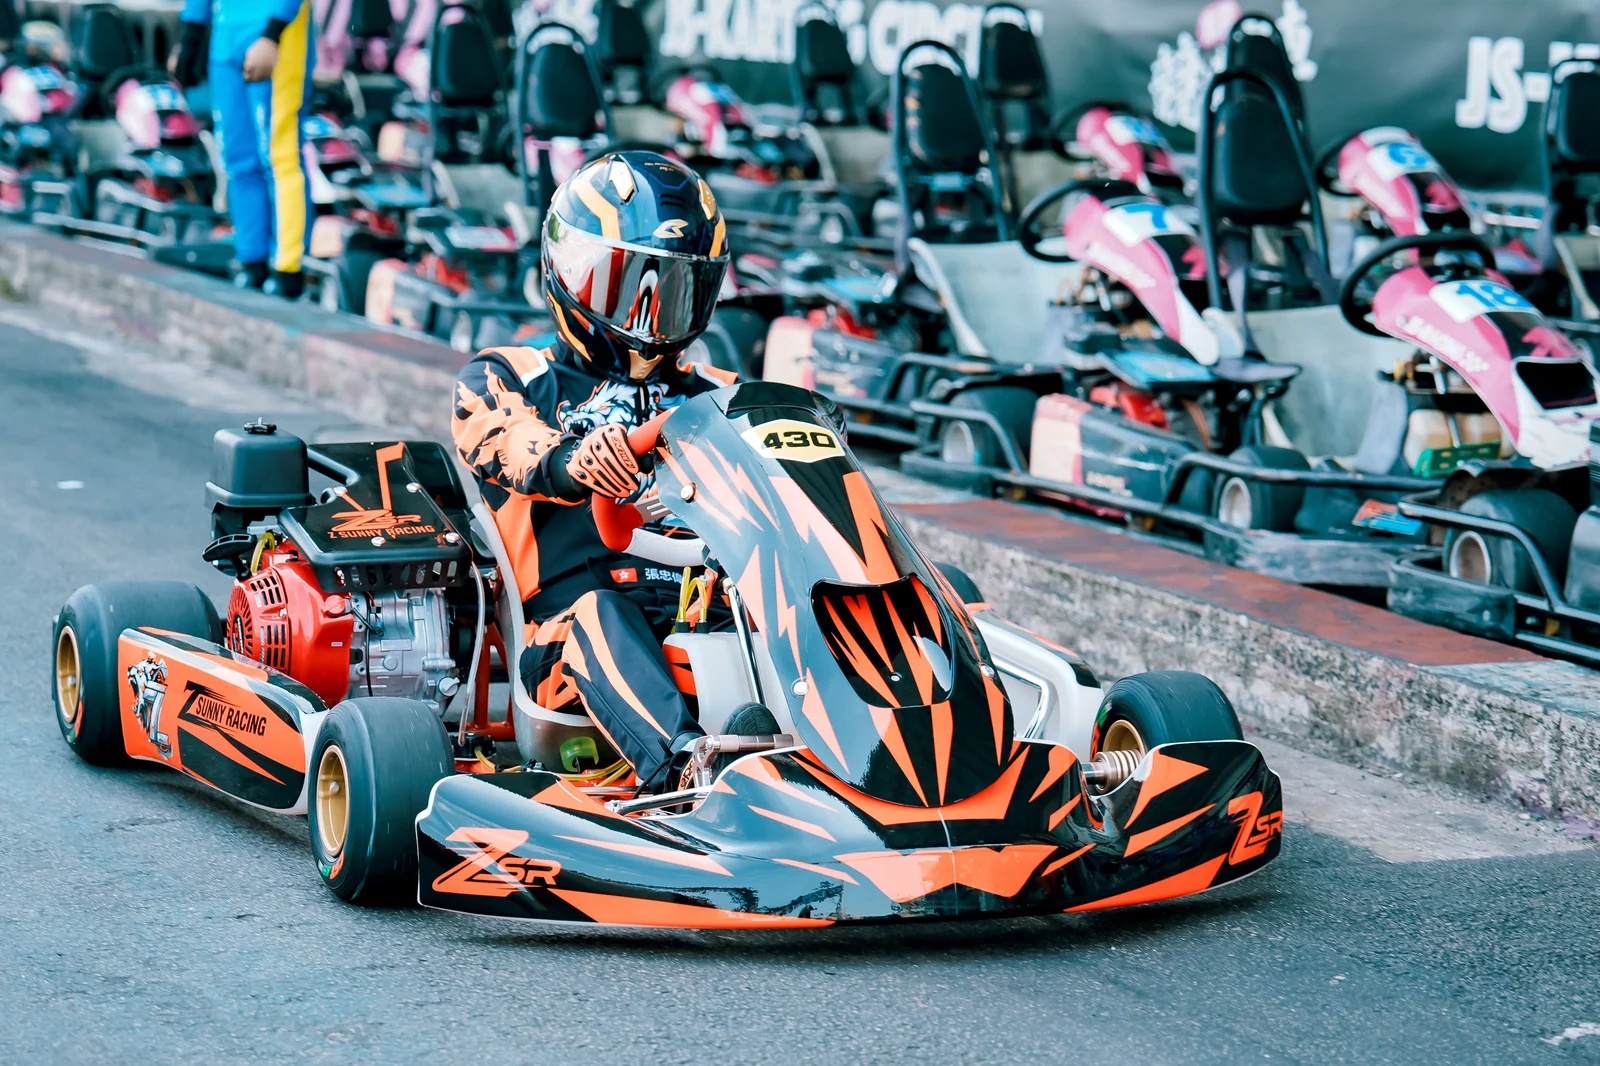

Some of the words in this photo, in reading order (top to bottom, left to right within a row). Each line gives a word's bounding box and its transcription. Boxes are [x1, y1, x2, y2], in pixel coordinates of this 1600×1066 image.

[1122, 203, 1168, 231] 7
[1456, 281, 1533, 309] 18
[763, 431, 836, 450] 430
[338, 528, 383, 539] SUNNY
[385, 525, 436, 539] RACING
[195, 695, 227, 724] SUNNY
[225, 709, 267, 737] RACING
[1227, 790, 1283, 866] ZSR
[431, 826, 562, 898] ZSR
